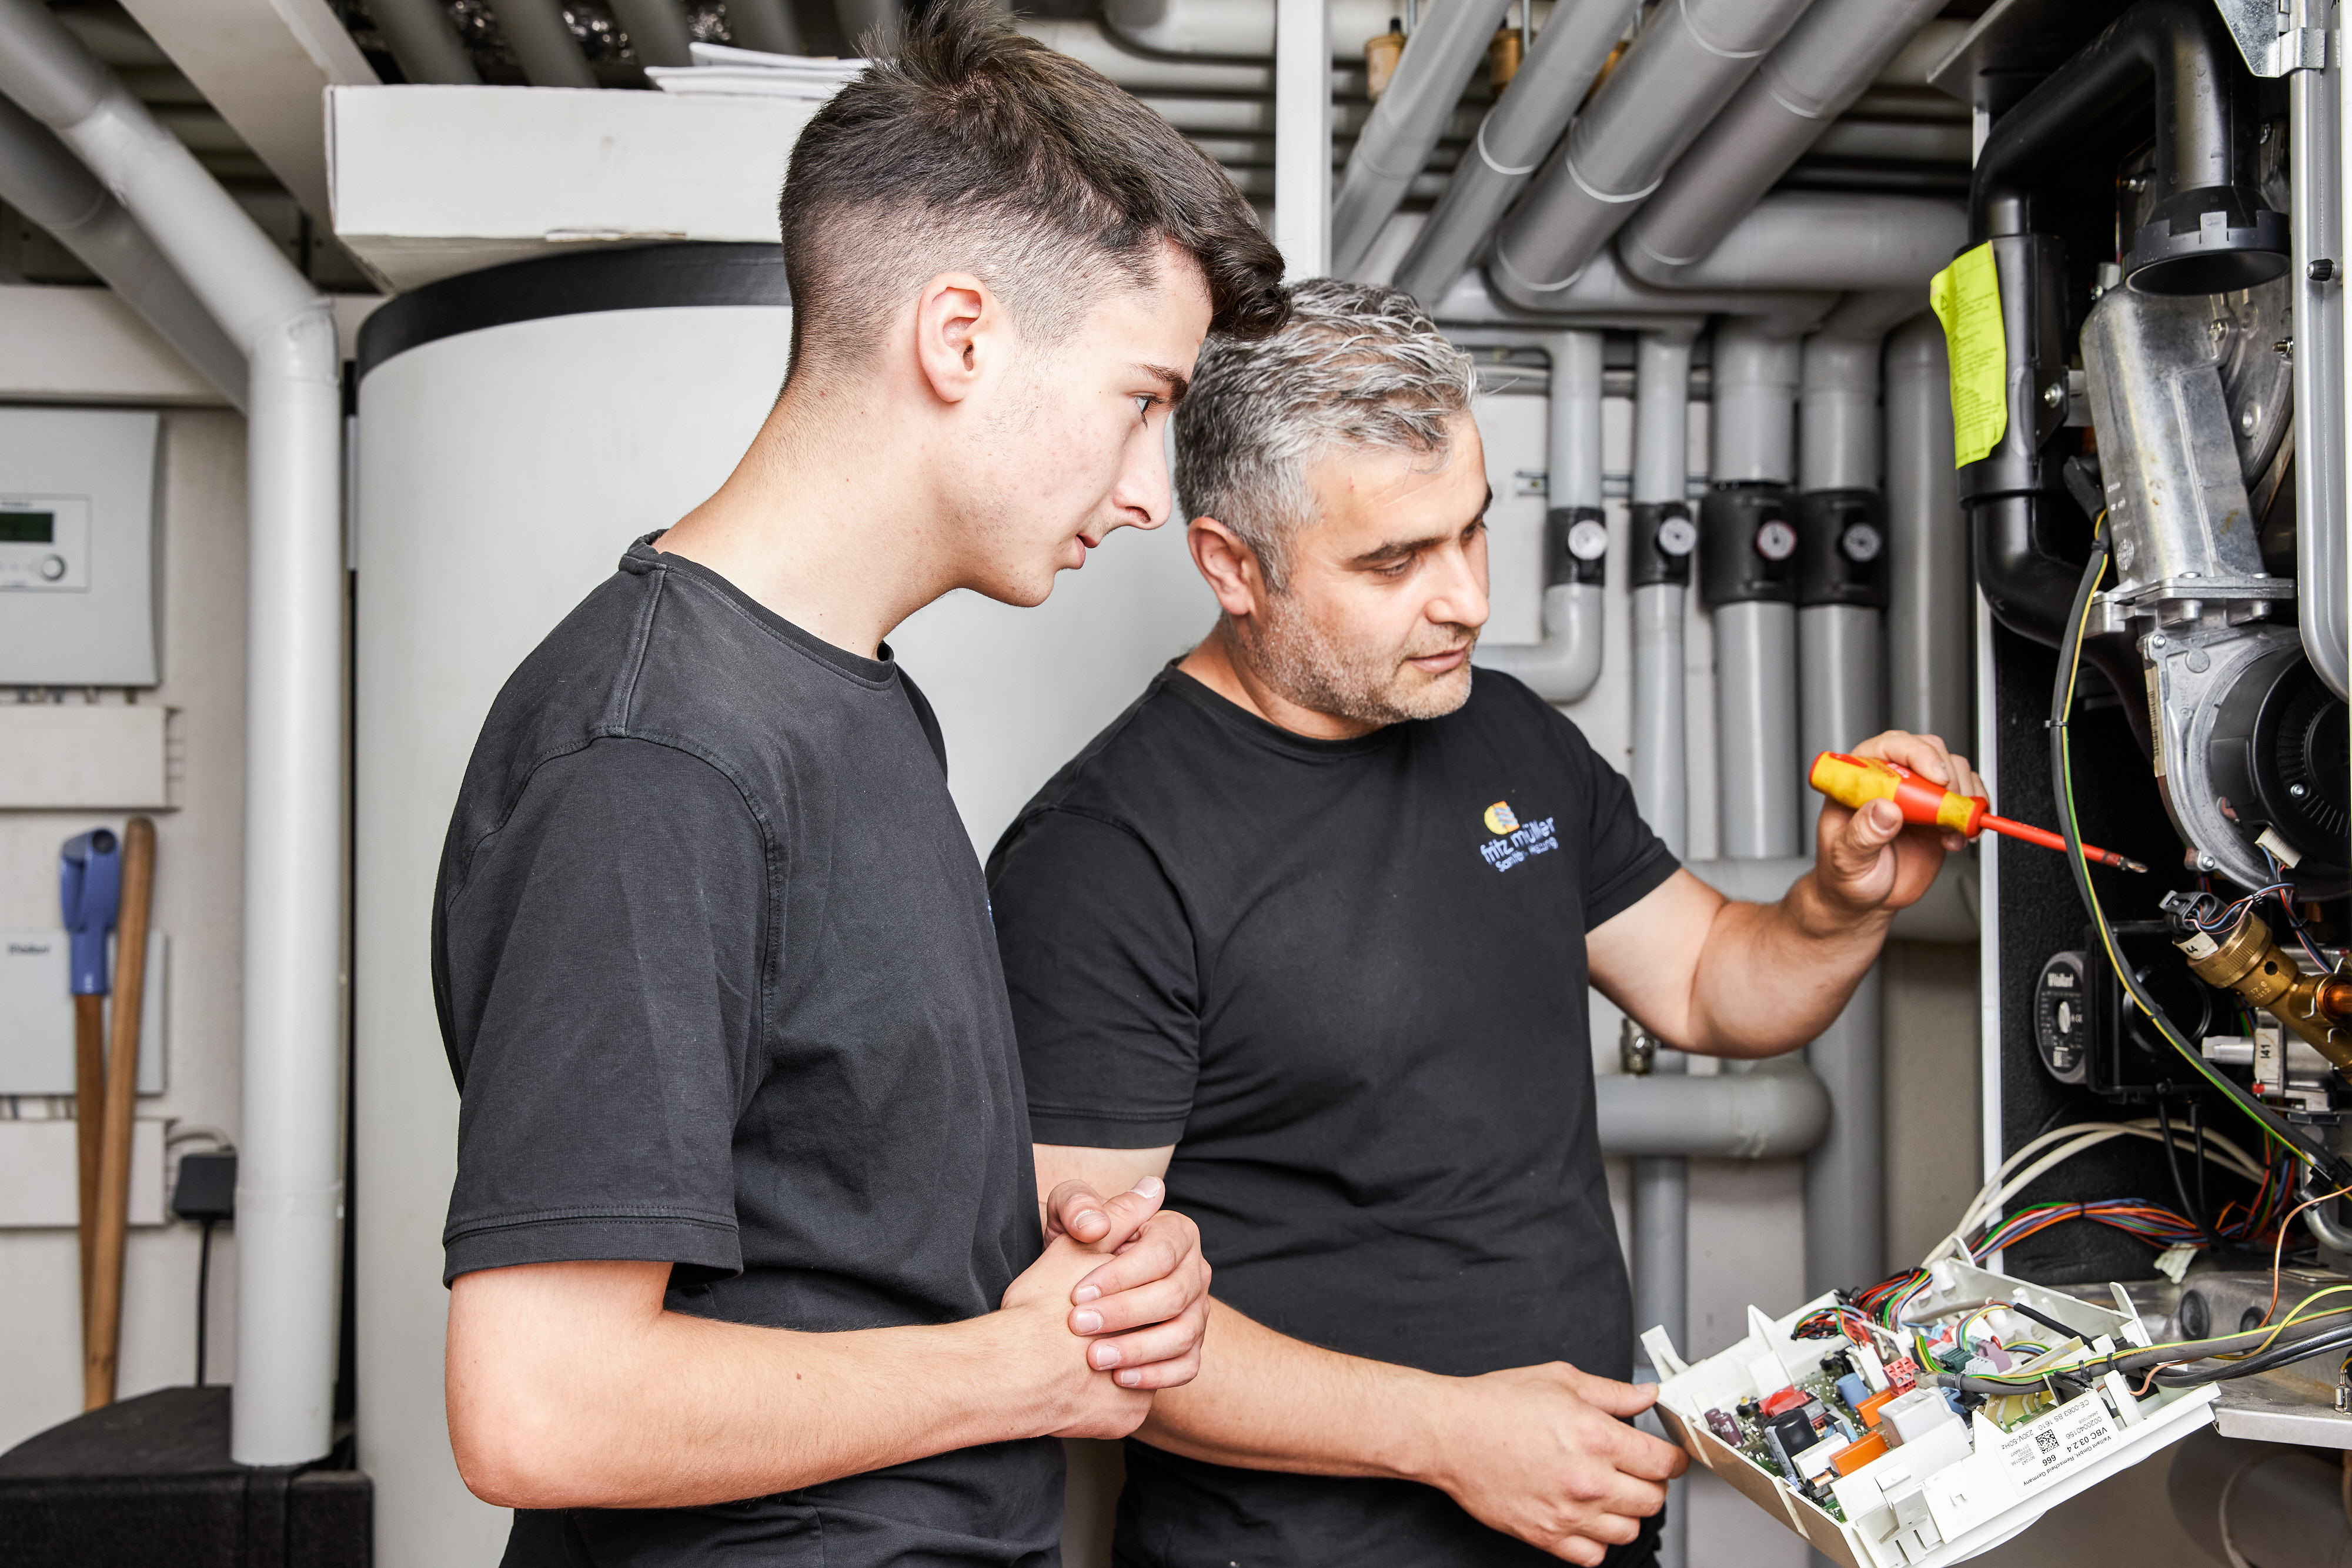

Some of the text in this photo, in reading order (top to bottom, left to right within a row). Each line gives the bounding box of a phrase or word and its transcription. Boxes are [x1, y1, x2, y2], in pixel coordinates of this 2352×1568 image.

[1480, 817, 1555, 864] fritz müller
[2064, 1400, 2089, 1416] CE-0063
[2039, 1420, 2053, 1430] 1610
[2066, 1417, 2102, 1439] 0020040156
[2002, 1430, 2033, 1449] 230V-50Hz
[2043, 1427, 2107, 1466] VBC 03.2.4 666
[2024, 1436, 2111, 1486] Vaillant GmbH, Remscheid Germany
